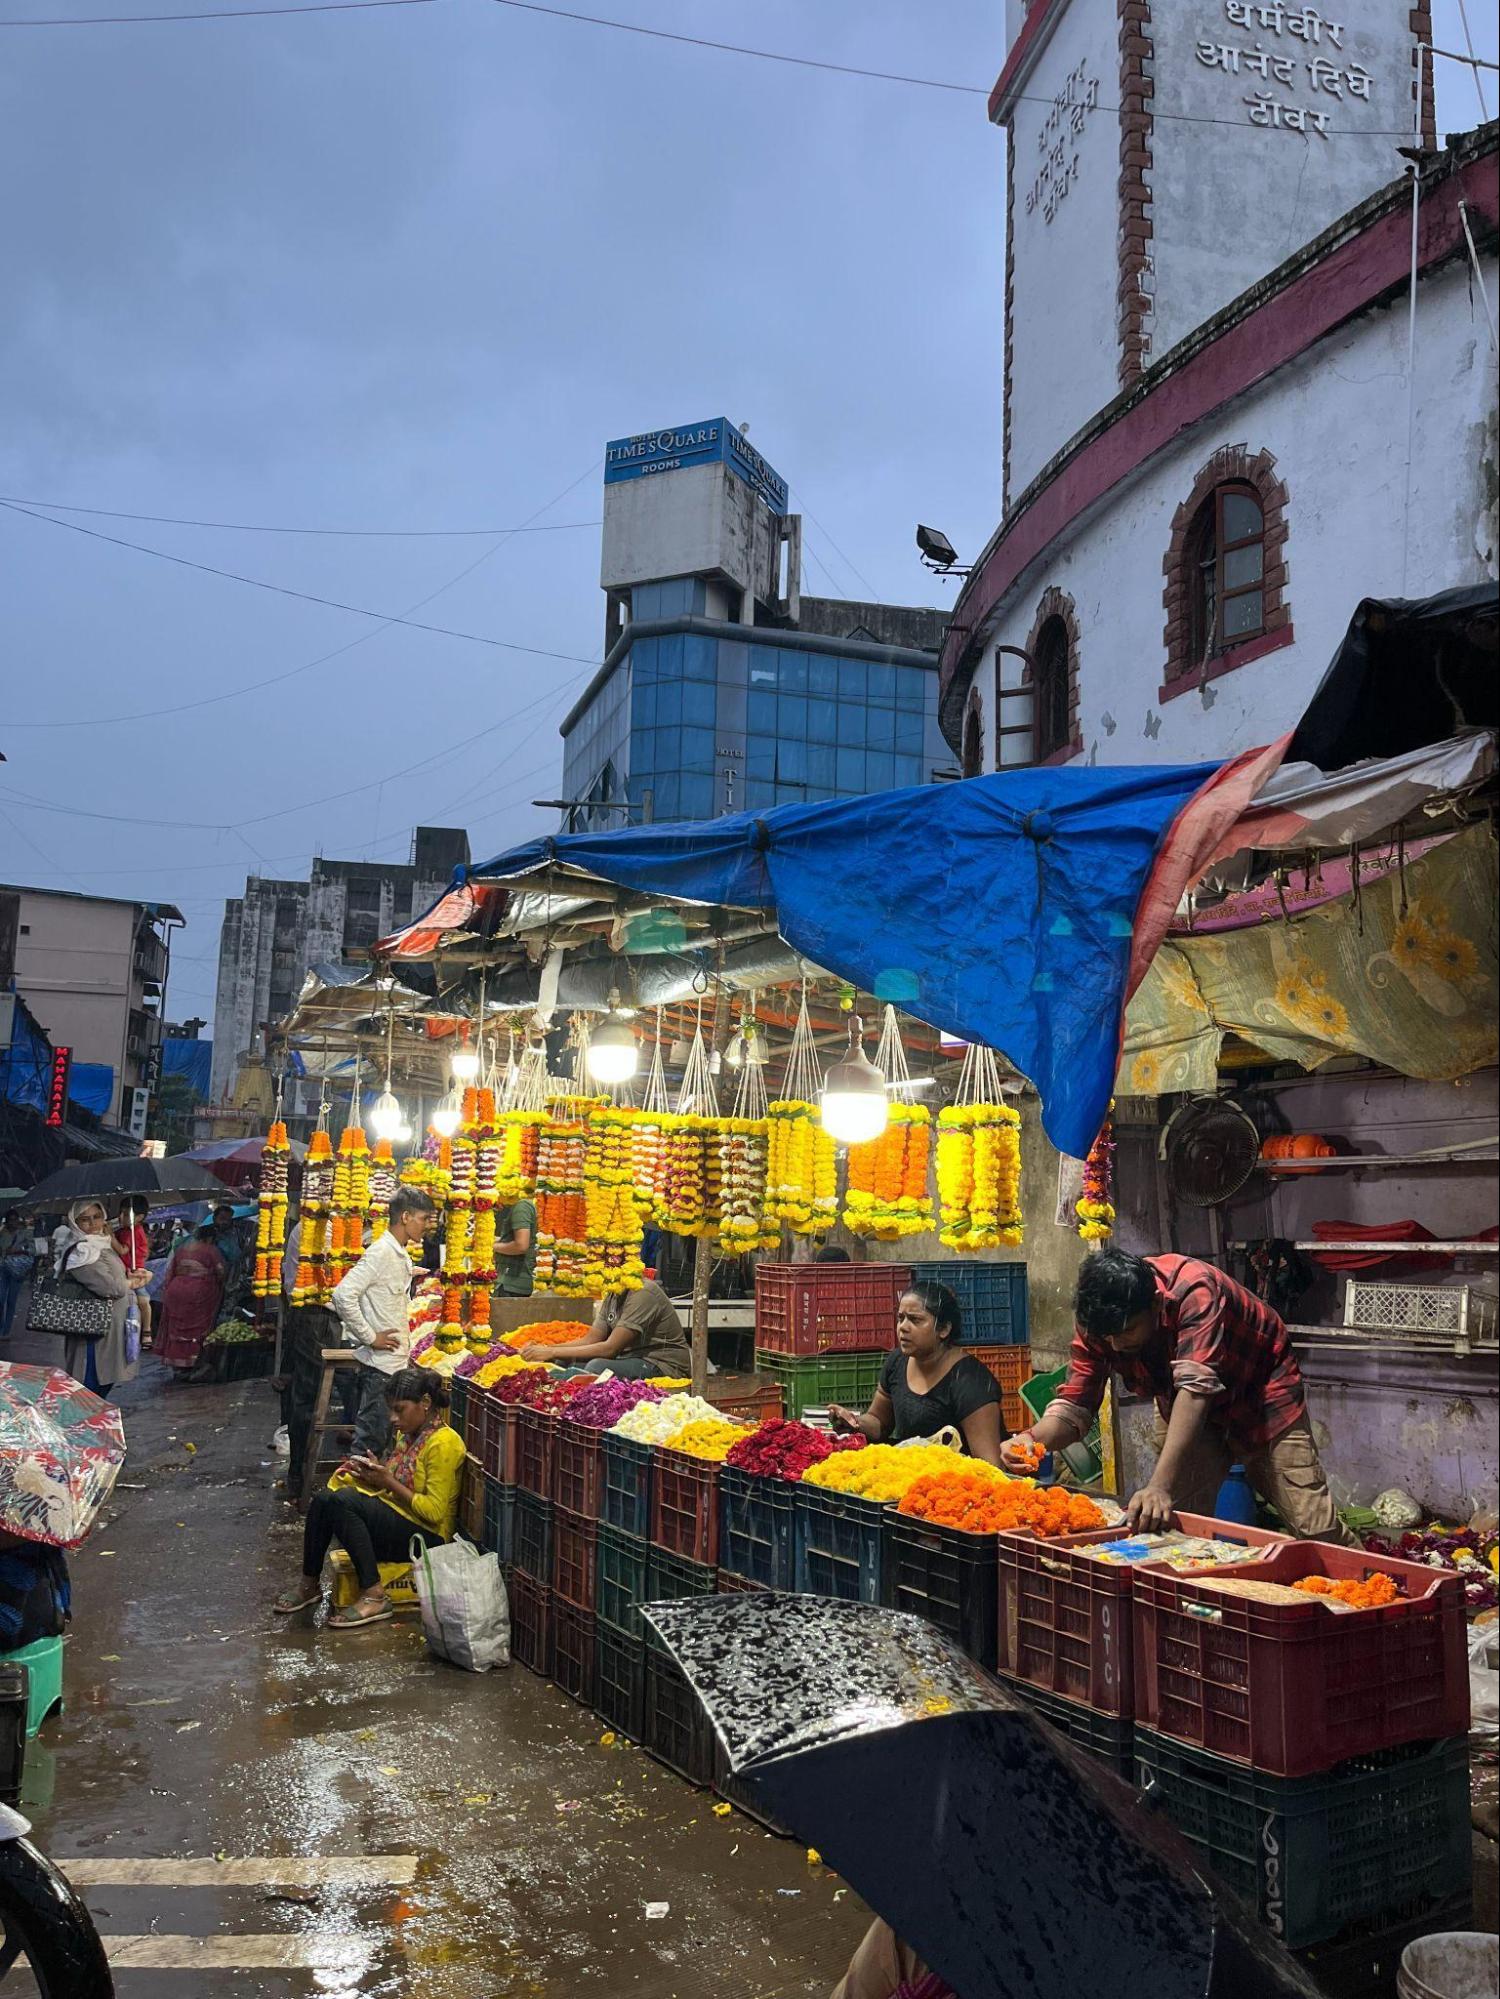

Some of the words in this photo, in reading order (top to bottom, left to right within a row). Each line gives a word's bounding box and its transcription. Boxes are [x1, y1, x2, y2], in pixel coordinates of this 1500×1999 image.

[1224, 0, 1344, 49] धर्मवीर
[1196, 40, 1296, 91] आनंद
[1306, 56, 1376, 102] दिघे
[1243, 91, 1330, 140] टॉवर
[642, 459, 681, 474] ROOMS
[50, 1047, 69, 1120] MAHARAJA
[1101, 1604, 1114, 1685] OTC
